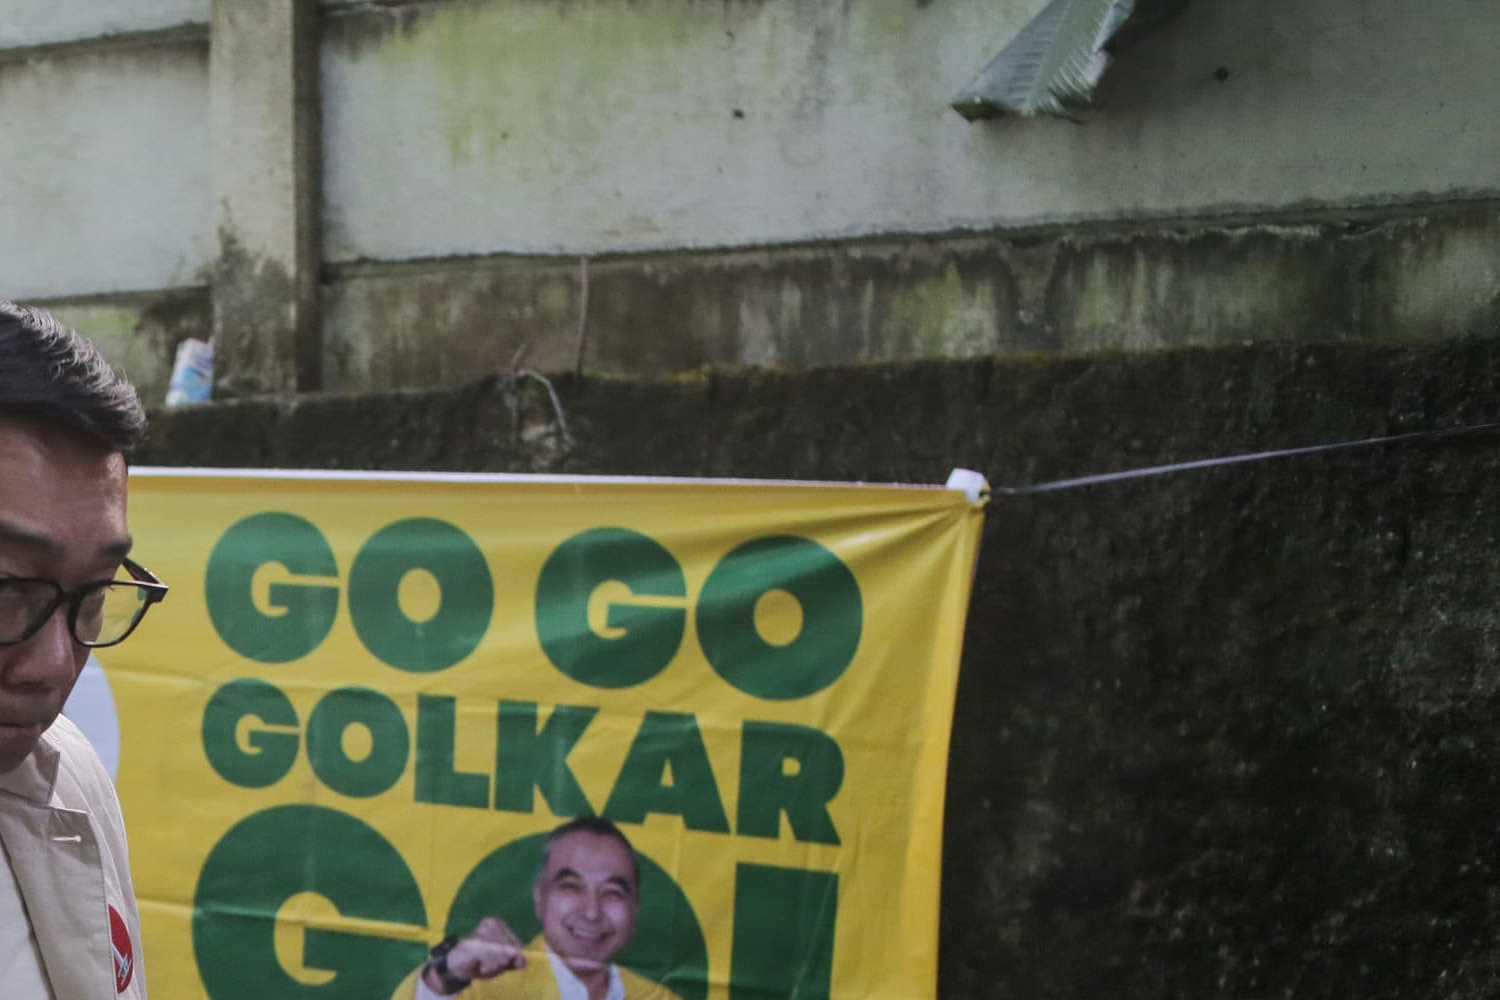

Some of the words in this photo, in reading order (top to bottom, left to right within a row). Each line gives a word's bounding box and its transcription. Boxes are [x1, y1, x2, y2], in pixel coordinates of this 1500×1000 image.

[204, 510, 495, 674] GO
[534, 526, 864, 701] GO
[201, 677, 845, 848] GOLKAR
